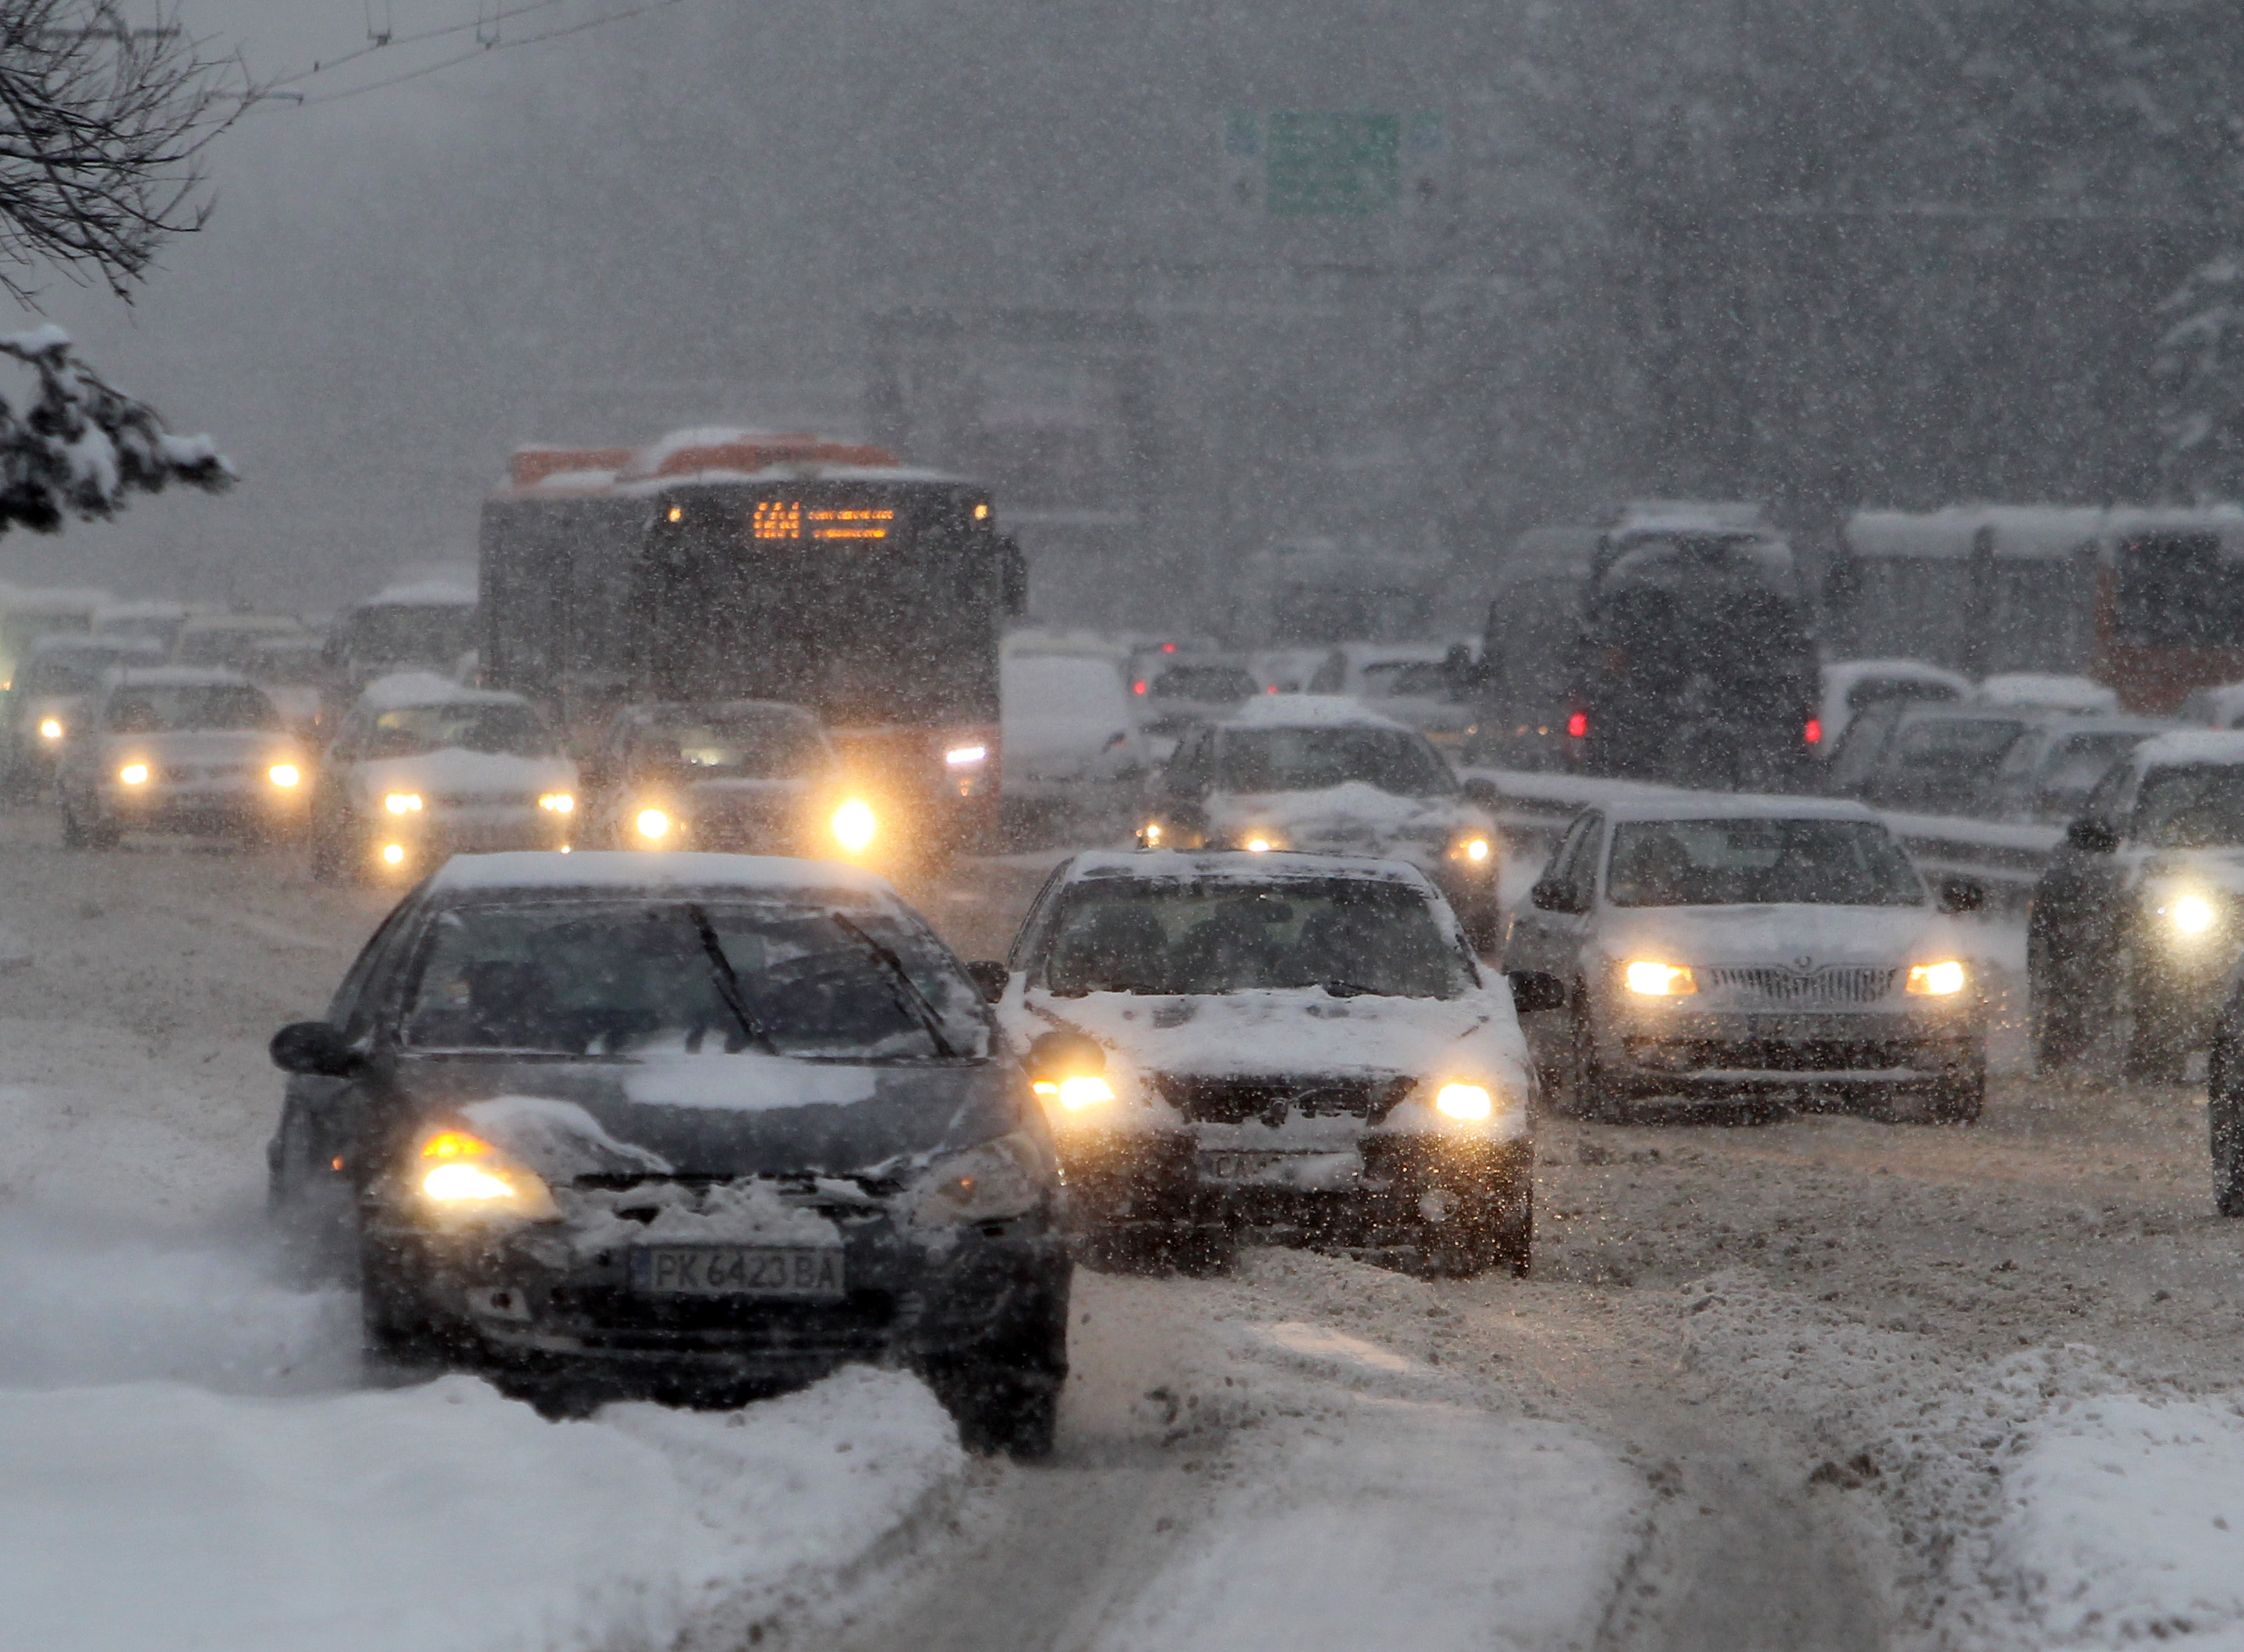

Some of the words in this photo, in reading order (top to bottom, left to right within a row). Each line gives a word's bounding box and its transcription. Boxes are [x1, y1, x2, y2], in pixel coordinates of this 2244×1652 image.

[656, 1253, 699, 1287] PK
[707, 1255, 788, 1287] 6423
[794, 1256, 836, 1288] BA
